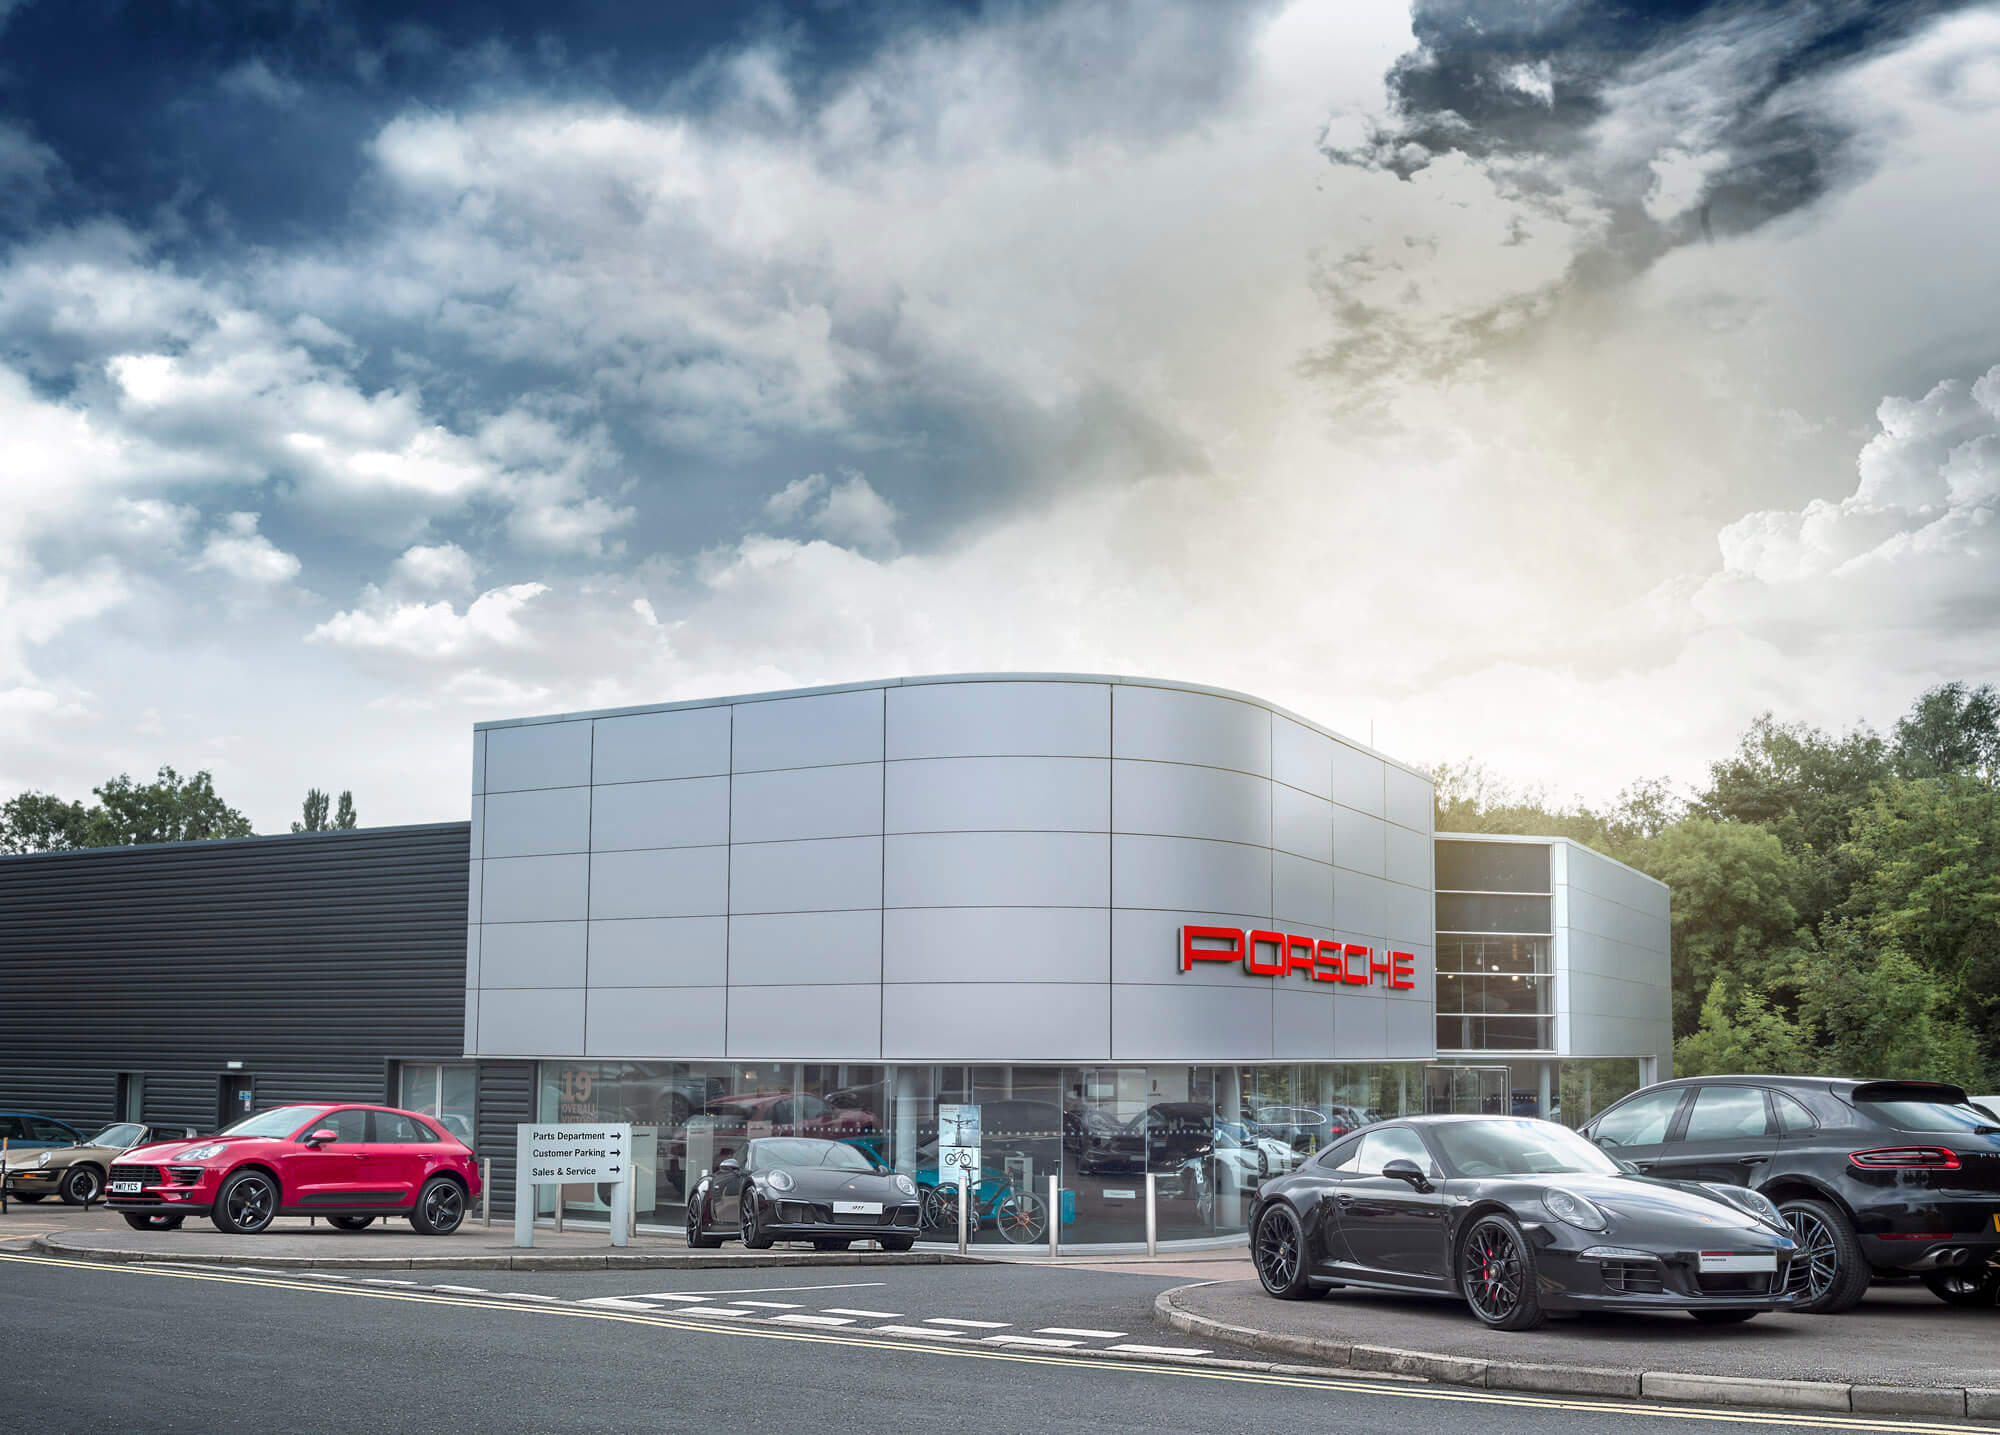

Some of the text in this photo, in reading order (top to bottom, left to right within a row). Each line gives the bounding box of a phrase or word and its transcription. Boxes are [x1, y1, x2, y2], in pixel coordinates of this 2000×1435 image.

[1181, 925, 1415, 989] PORSCHE
[561, 1103, 596, 1113] OVERALL
[533, 1132, 605, 1141] Parts Department
[532, 1148, 606, 1158] Customer Parking
[532, 1167, 597, 1176] Sales & Service
